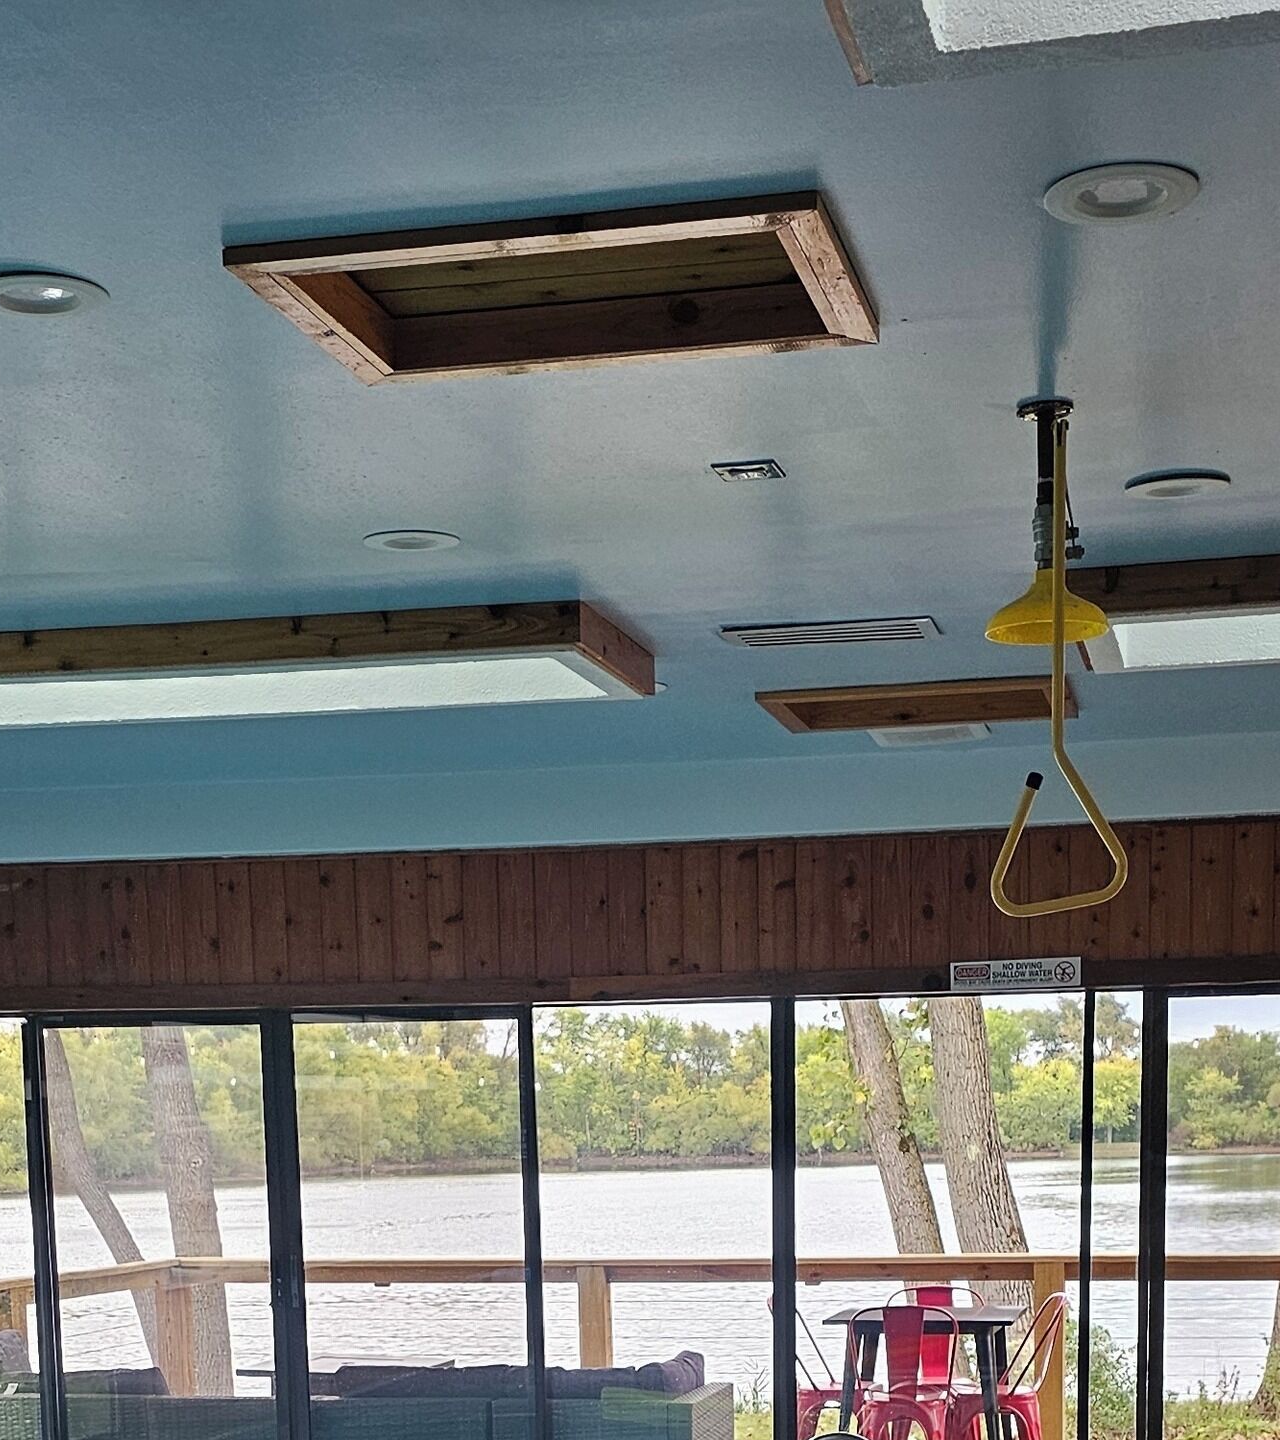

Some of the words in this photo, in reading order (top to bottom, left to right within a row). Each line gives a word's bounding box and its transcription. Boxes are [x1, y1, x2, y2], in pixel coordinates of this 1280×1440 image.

[1002, 962, 1014, 971] NO
[1016, 961, 1043, 970] DIVING
[956, 967, 987, 978] DANGER
[992, 969, 1027, 979] SHALLOW
[1029, 968, 1053, 978] WATER
